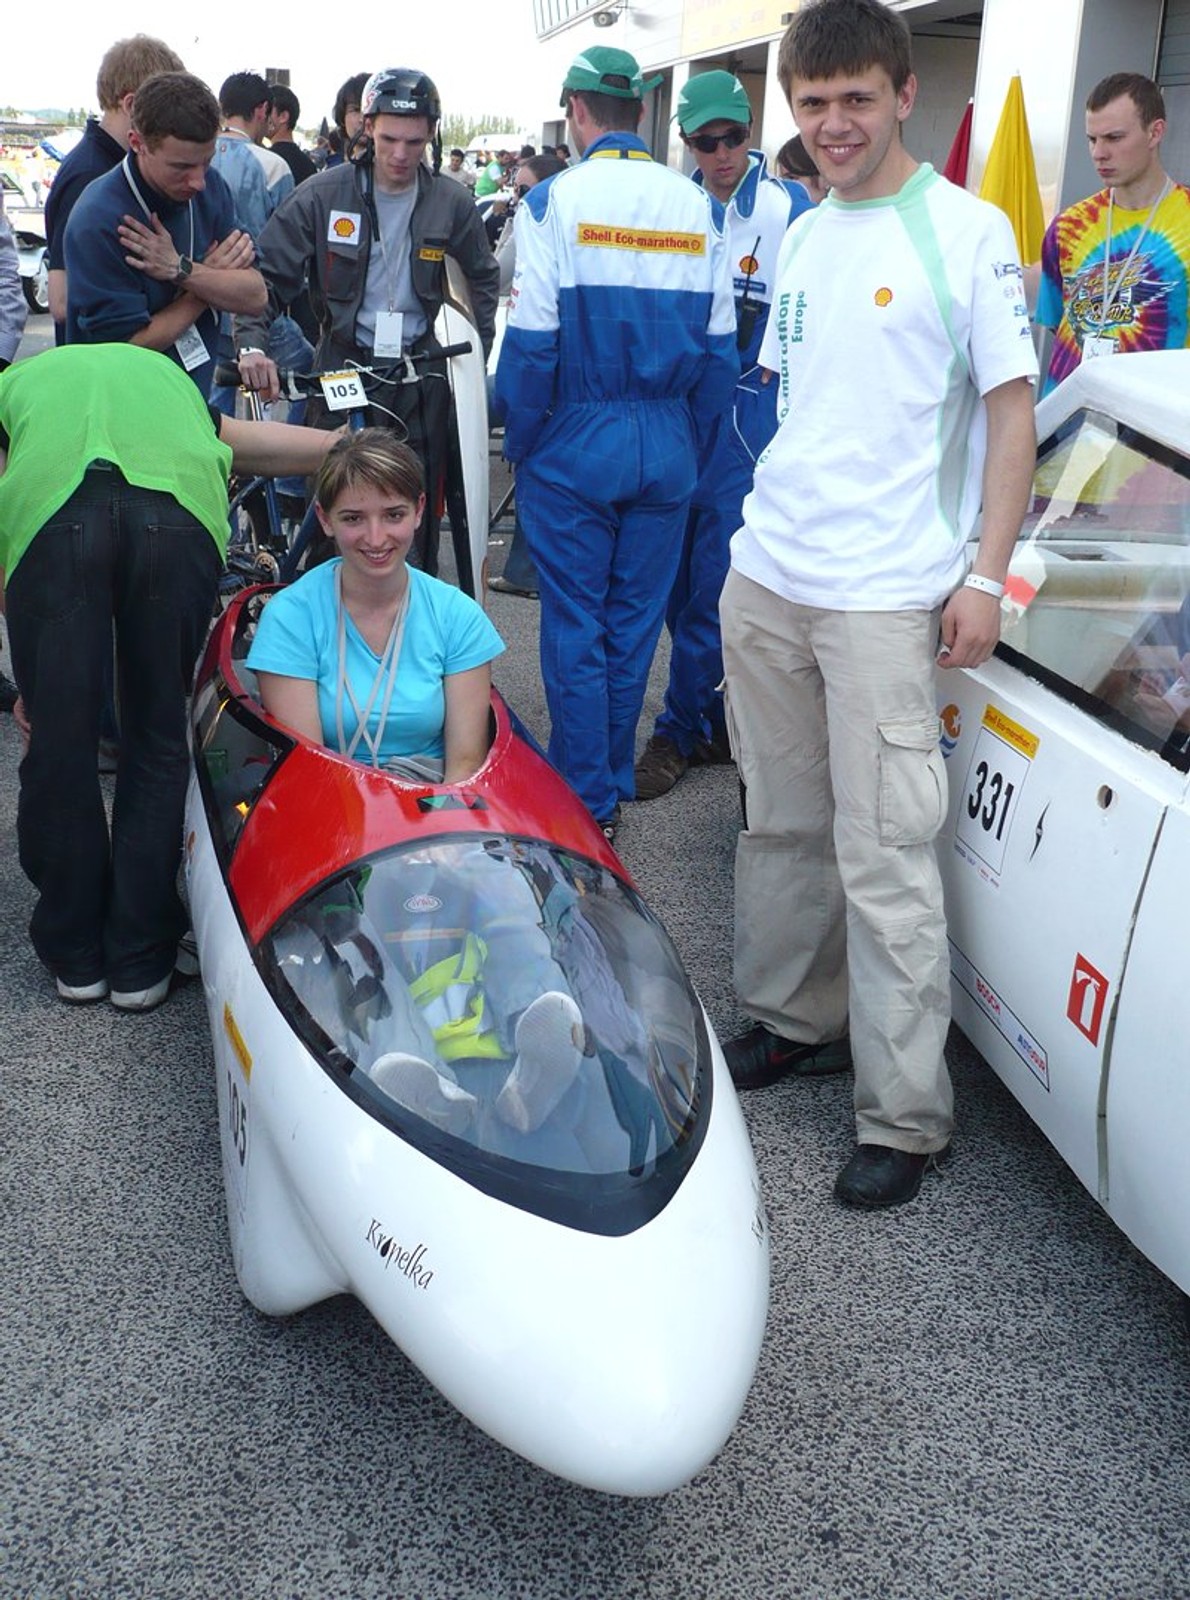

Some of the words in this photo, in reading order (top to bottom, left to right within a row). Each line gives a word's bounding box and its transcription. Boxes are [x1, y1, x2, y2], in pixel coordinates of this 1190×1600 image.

[583, 229, 611, 242] Shell
[615, 232, 690, 250] Eco-marathon
[792, 290, 807, 343] Europe
[329, 383, 358, 399] 105
[967, 761, 1014, 842] 331
[227, 1069, 247, 1168] 105
